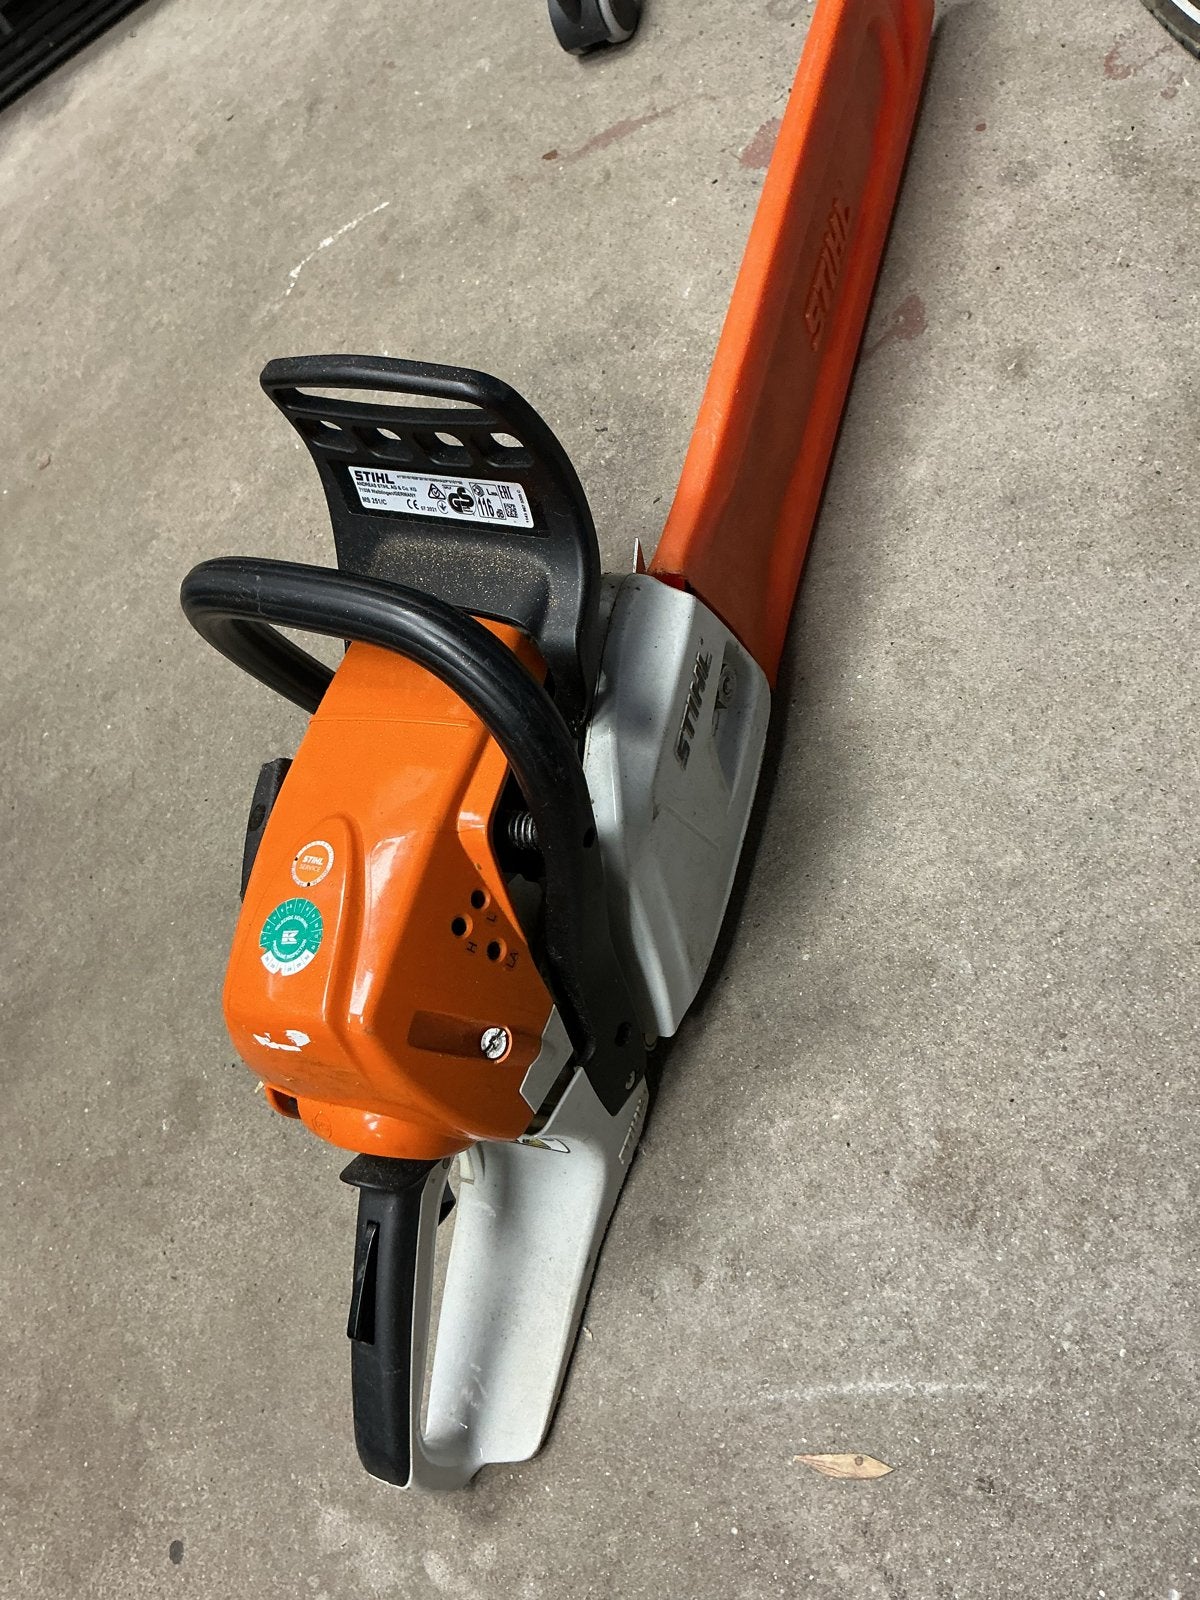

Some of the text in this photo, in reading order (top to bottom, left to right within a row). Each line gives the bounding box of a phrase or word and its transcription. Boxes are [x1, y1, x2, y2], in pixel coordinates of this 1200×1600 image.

[804, 198, 850, 351] STIHL
[354, 470, 395, 485] STIHL
[478, 497, 495, 517] 116
[674, 651, 713, 771] STIHL
[299, 863, 322, 872] SERVICE
[302, 855, 324, 866] STIHL
[506, 951, 519, 968] LA
